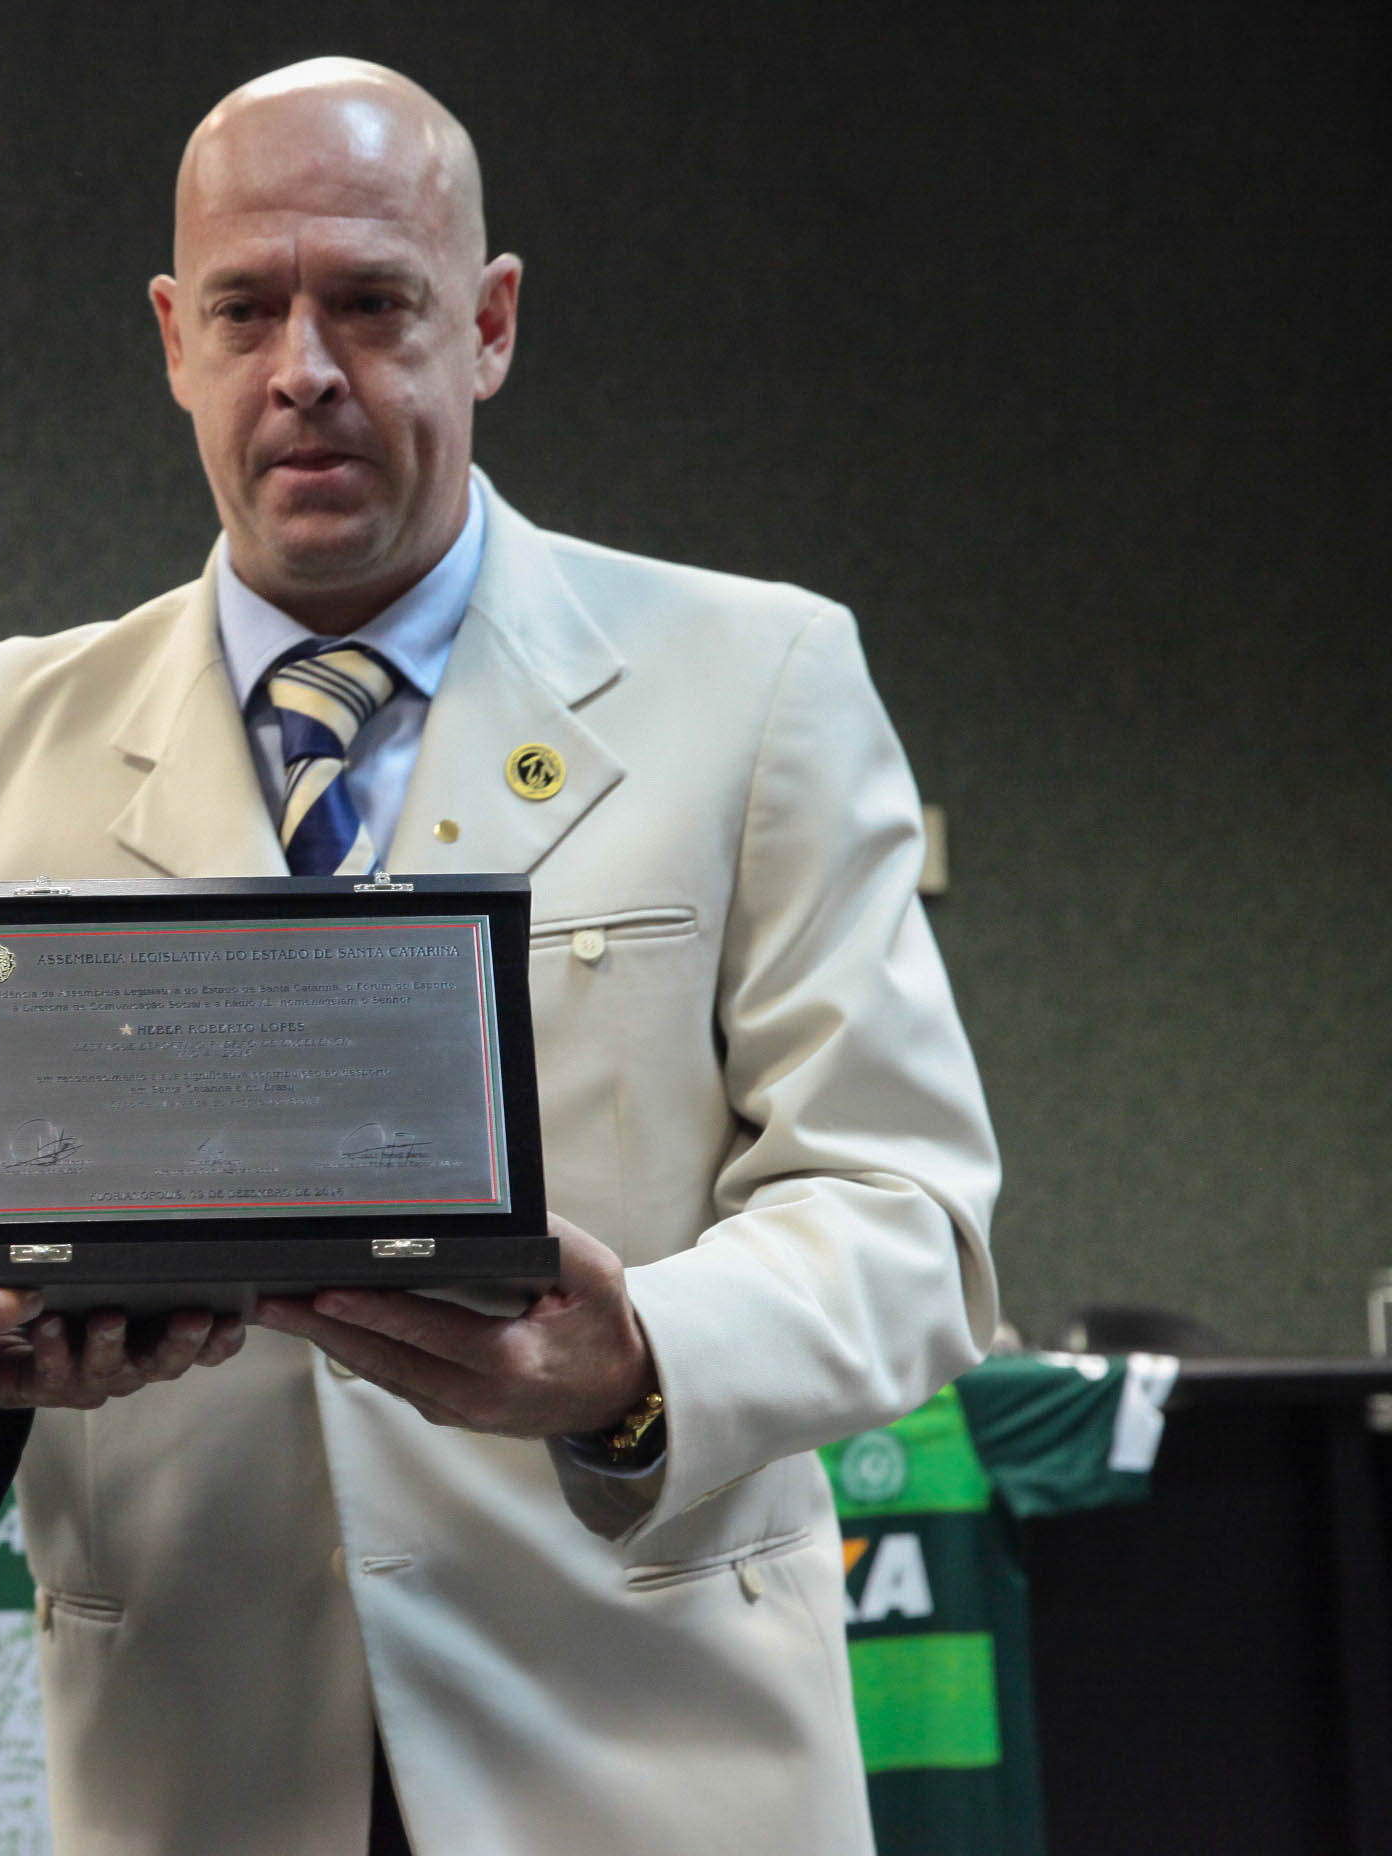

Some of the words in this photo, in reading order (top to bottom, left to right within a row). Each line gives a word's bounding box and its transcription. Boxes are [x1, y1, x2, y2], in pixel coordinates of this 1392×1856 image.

[36, 952, 125, 967] ASSEMBLEIA
[129, 949, 222, 964] LEGISLATIVA
[225, 949, 248, 961] DO
[252, 948, 310, 961] ESTADO
[314, 947, 334, 960] DE
[338, 946, 385, 959] SANTA
[388, 944, 460, 958] CATARINA
[202, 984, 239, 995] Estado
[259, 983, 290, 994] Santa
[168, 999, 201, 1010] Social
[371, 994, 412, 1006] Senhor
[136, 1023, 183, 1036] HEBER
[187, 1022, 255, 1035] ROBERTO
[260, 1021, 305, 1033] LOPES
